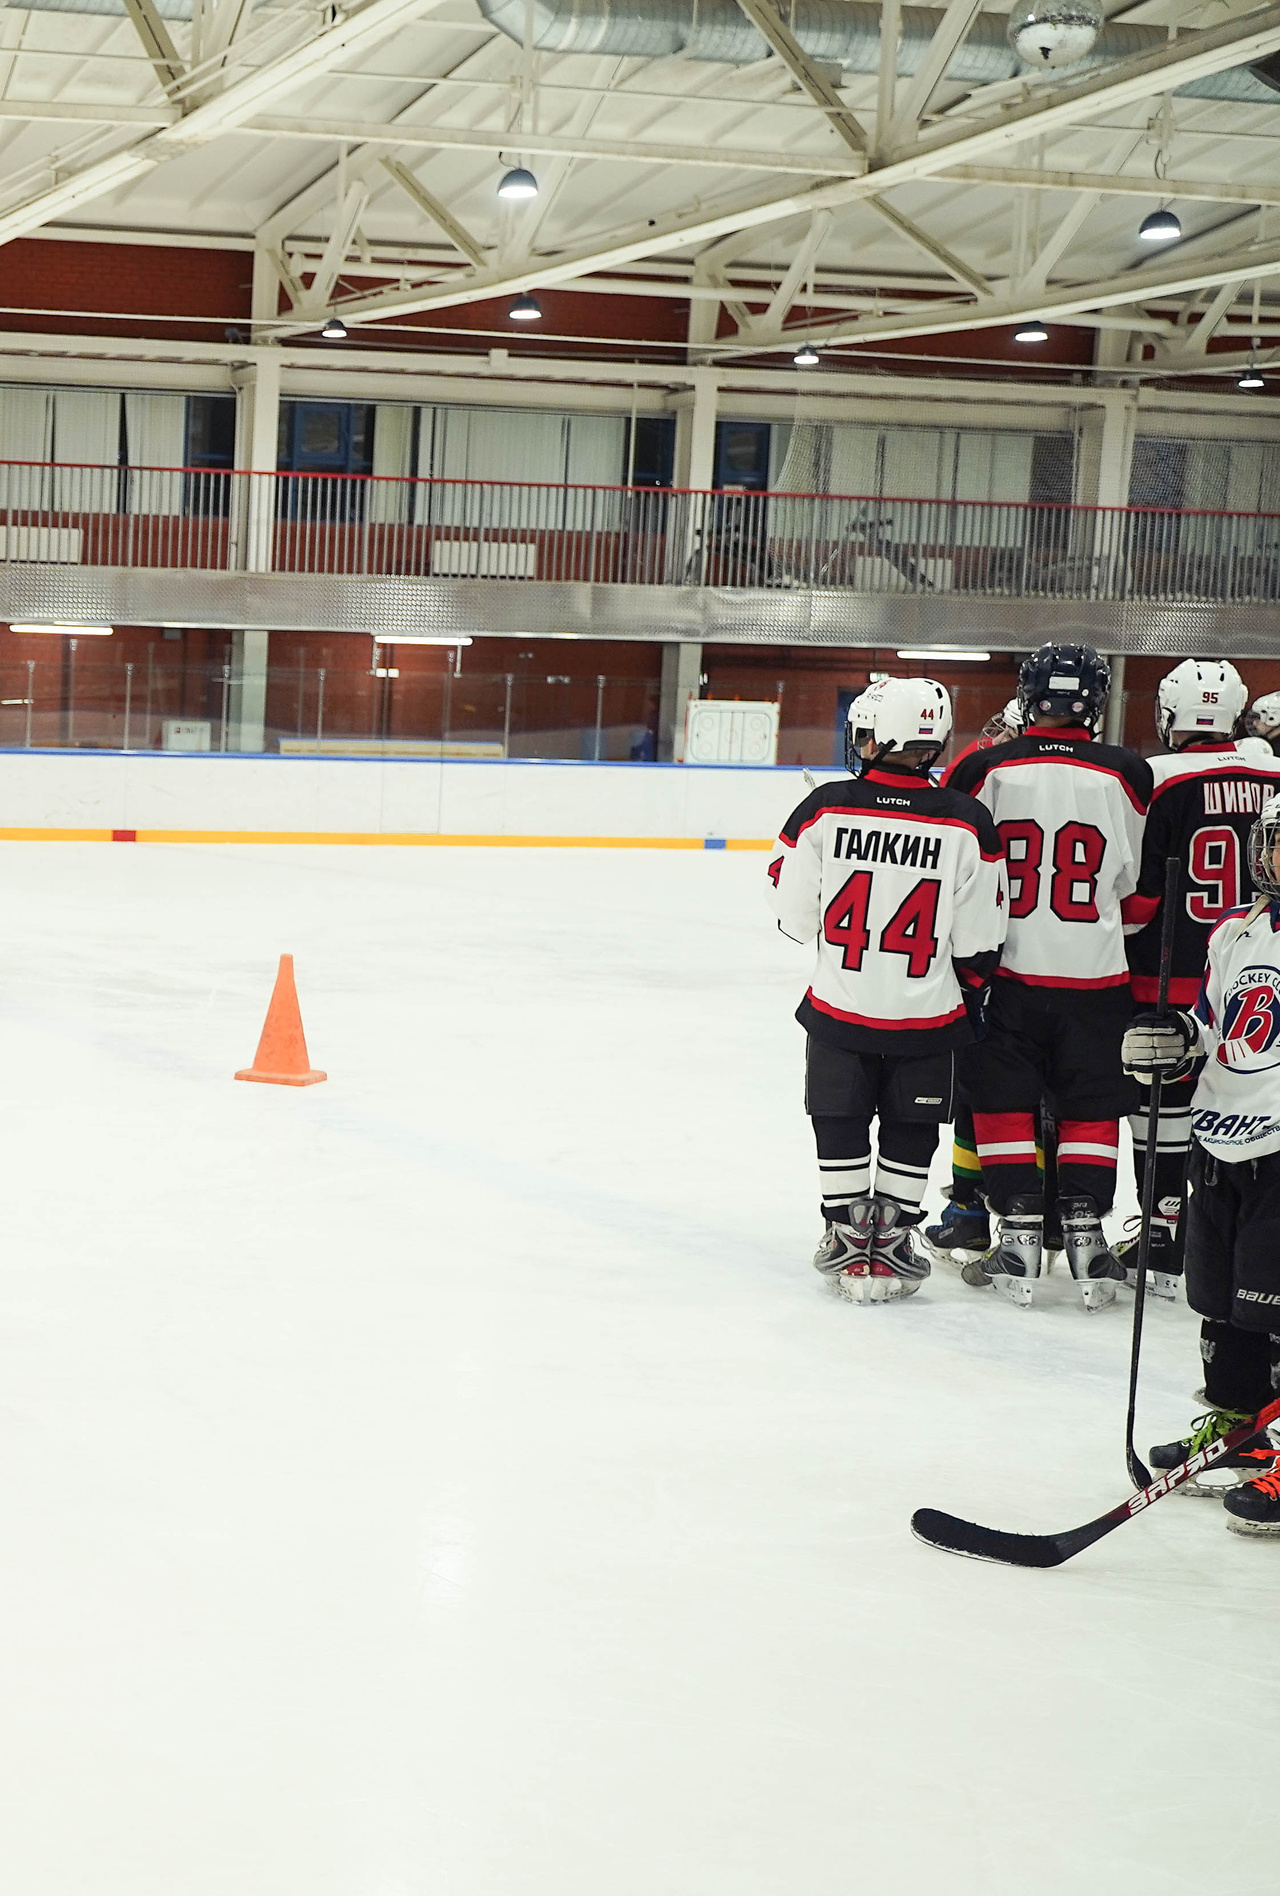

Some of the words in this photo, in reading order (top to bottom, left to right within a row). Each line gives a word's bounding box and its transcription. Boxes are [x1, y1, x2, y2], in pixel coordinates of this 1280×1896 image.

[1202, 692, 1219, 703] 95
[920, 709, 934, 720] 44
[1039, 744, 1074, 753] LUTCH
[876, 796, 911, 806] LUTCH
[833, 827, 942, 870] ГАЛКИН
[823, 869, 942, 979] 44
[1236, 1288, 1280, 1305] BAUE
